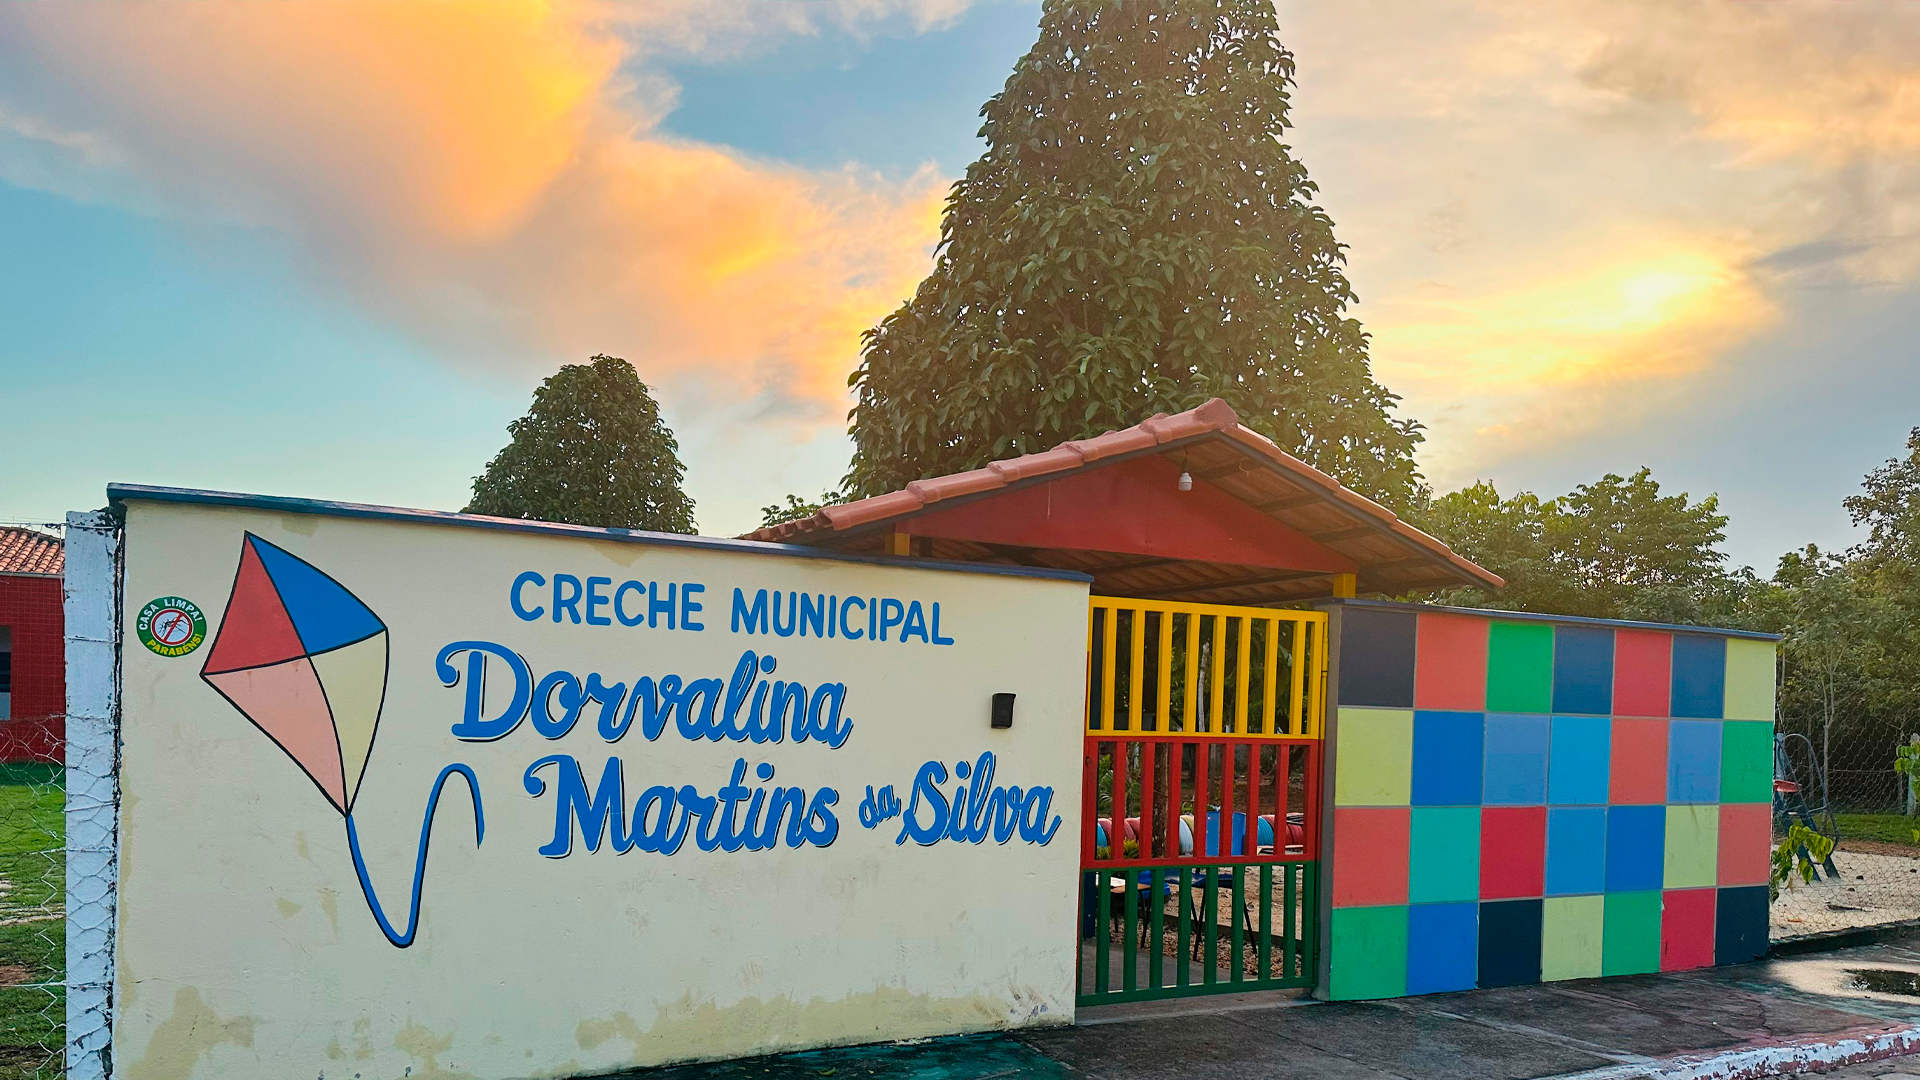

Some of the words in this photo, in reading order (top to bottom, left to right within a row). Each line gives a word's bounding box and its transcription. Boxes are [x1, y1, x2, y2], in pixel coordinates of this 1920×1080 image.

[139, 604, 159, 630] CASA
[163, 598, 203, 622] LIMPA!
[511, 571, 706, 632] CRECHE
[730, 588, 955, 646] MUNICIPAL
[436, 640, 855, 750] Dorvalina
[523, 753, 840, 858] Martins
[858, 784, 902, 831] da
[894, 750, 1062, 848] Silva
